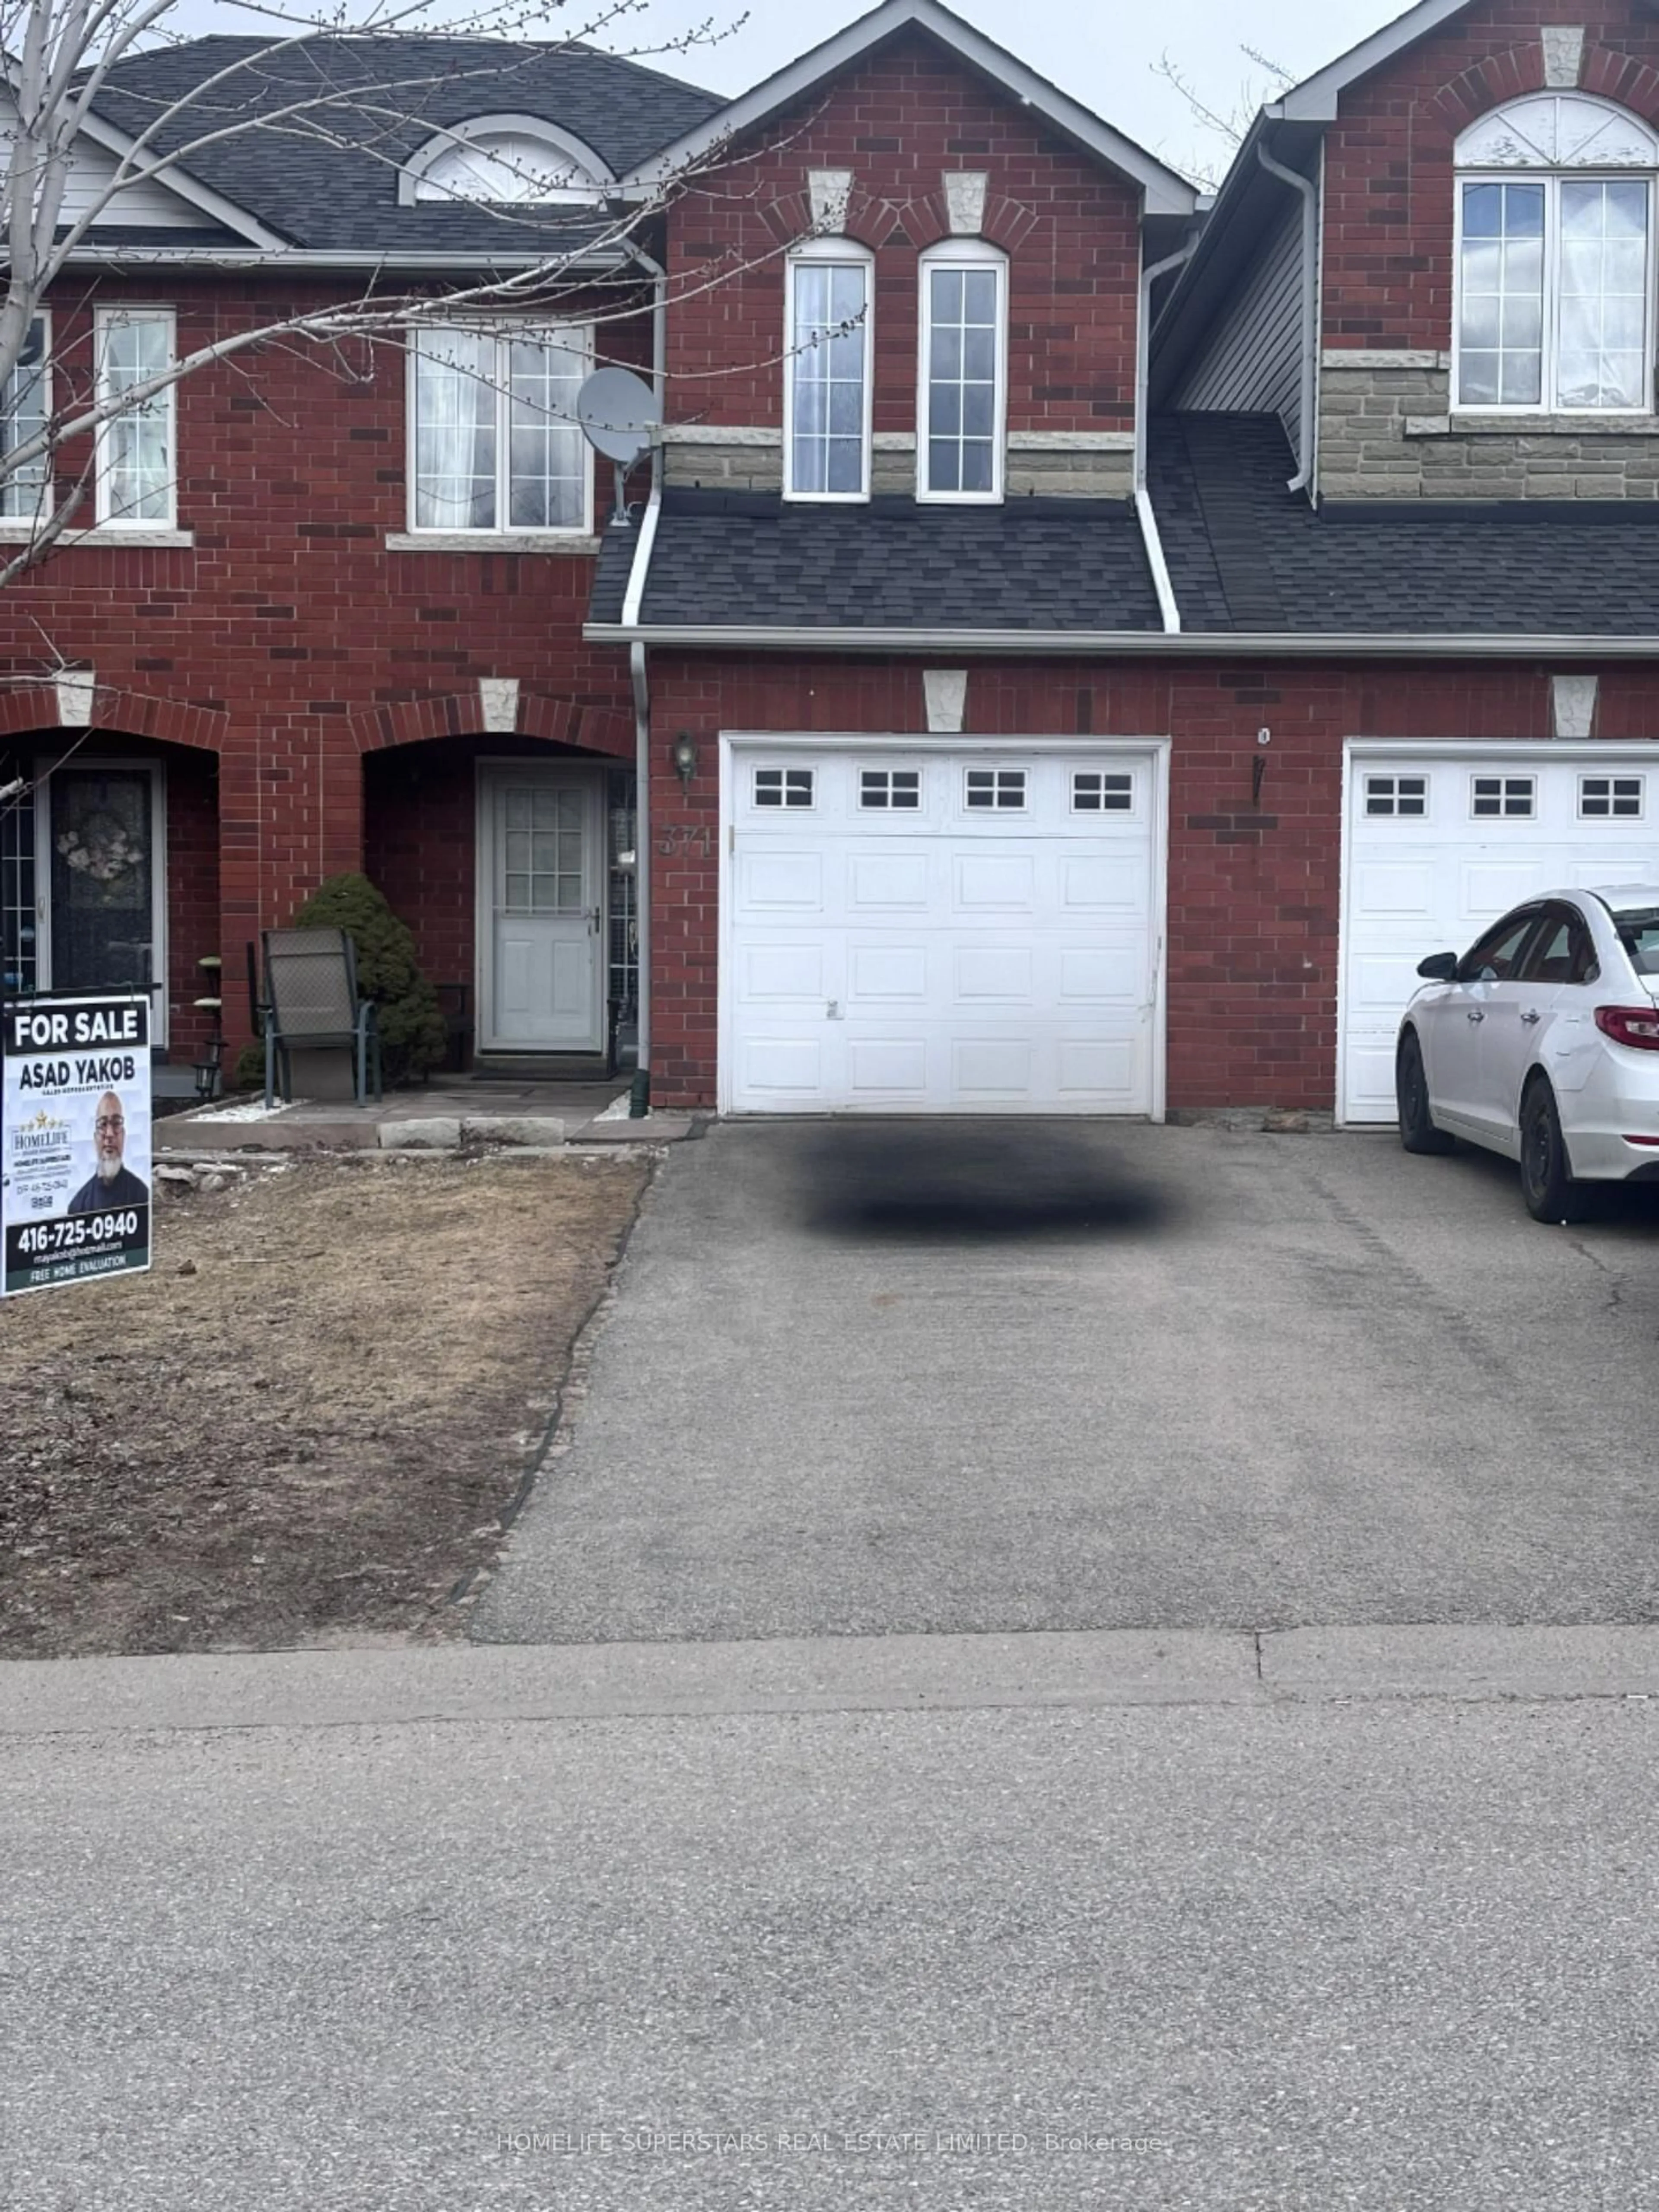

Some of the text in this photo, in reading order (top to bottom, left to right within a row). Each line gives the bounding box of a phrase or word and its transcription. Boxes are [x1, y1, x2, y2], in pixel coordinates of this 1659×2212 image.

[15, 1010, 137, 1046] FOR SALE
[19, 1055, 135, 1090] ASAD YAKOB
[18, 1211, 137, 1252] 416-725-0940
[30, 1254, 127, 1283] FREE HOME EVALUATION
